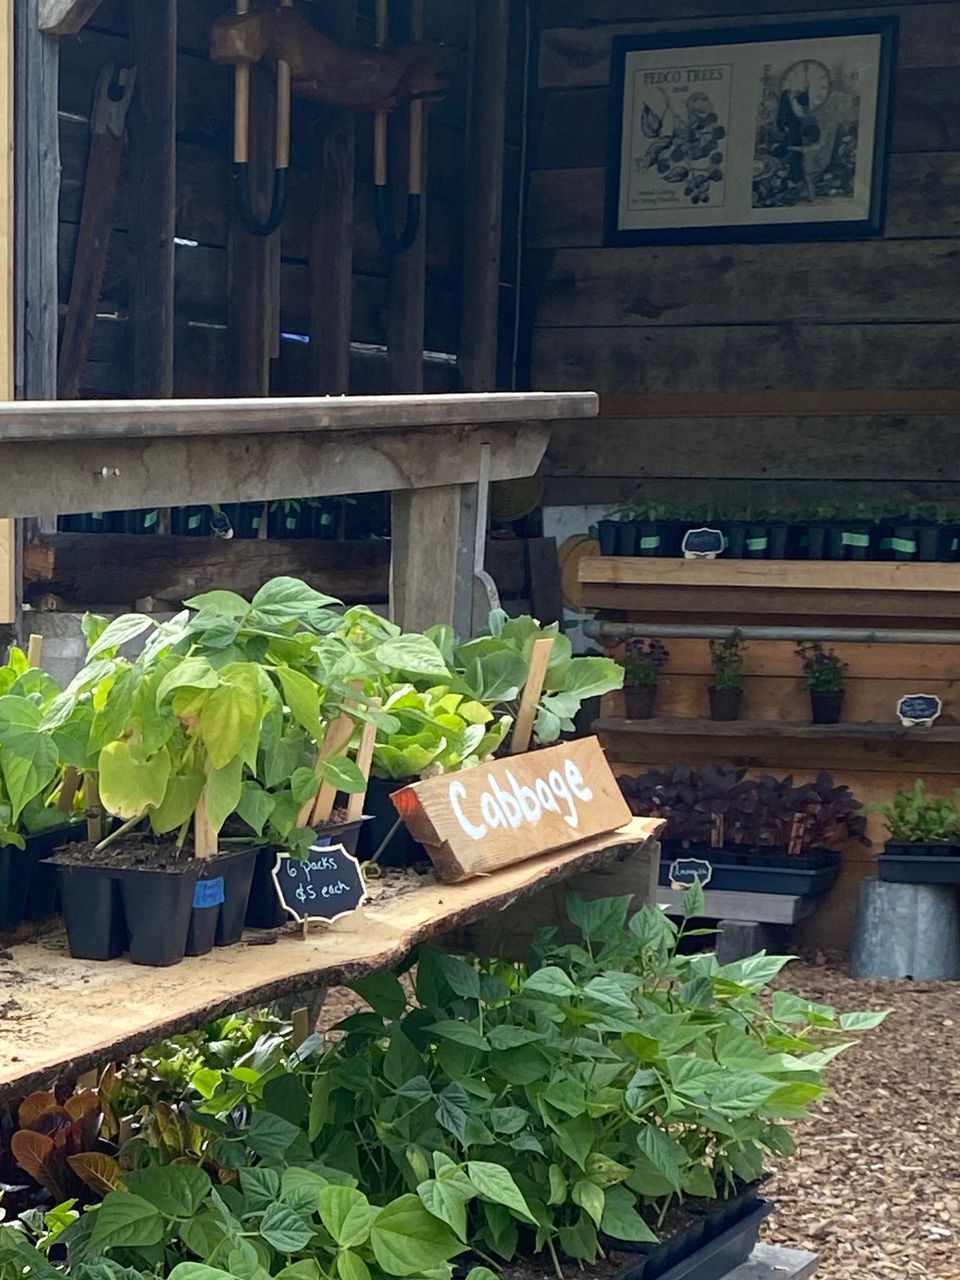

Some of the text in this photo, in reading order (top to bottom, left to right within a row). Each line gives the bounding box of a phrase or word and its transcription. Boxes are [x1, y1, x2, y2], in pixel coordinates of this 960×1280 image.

[643, 67, 724, 85] FEDCO TREES
[448, 758, 593, 841] Cabbage
[286, 859, 297, 877] 6
[295, 881, 350, 903] $5 each
